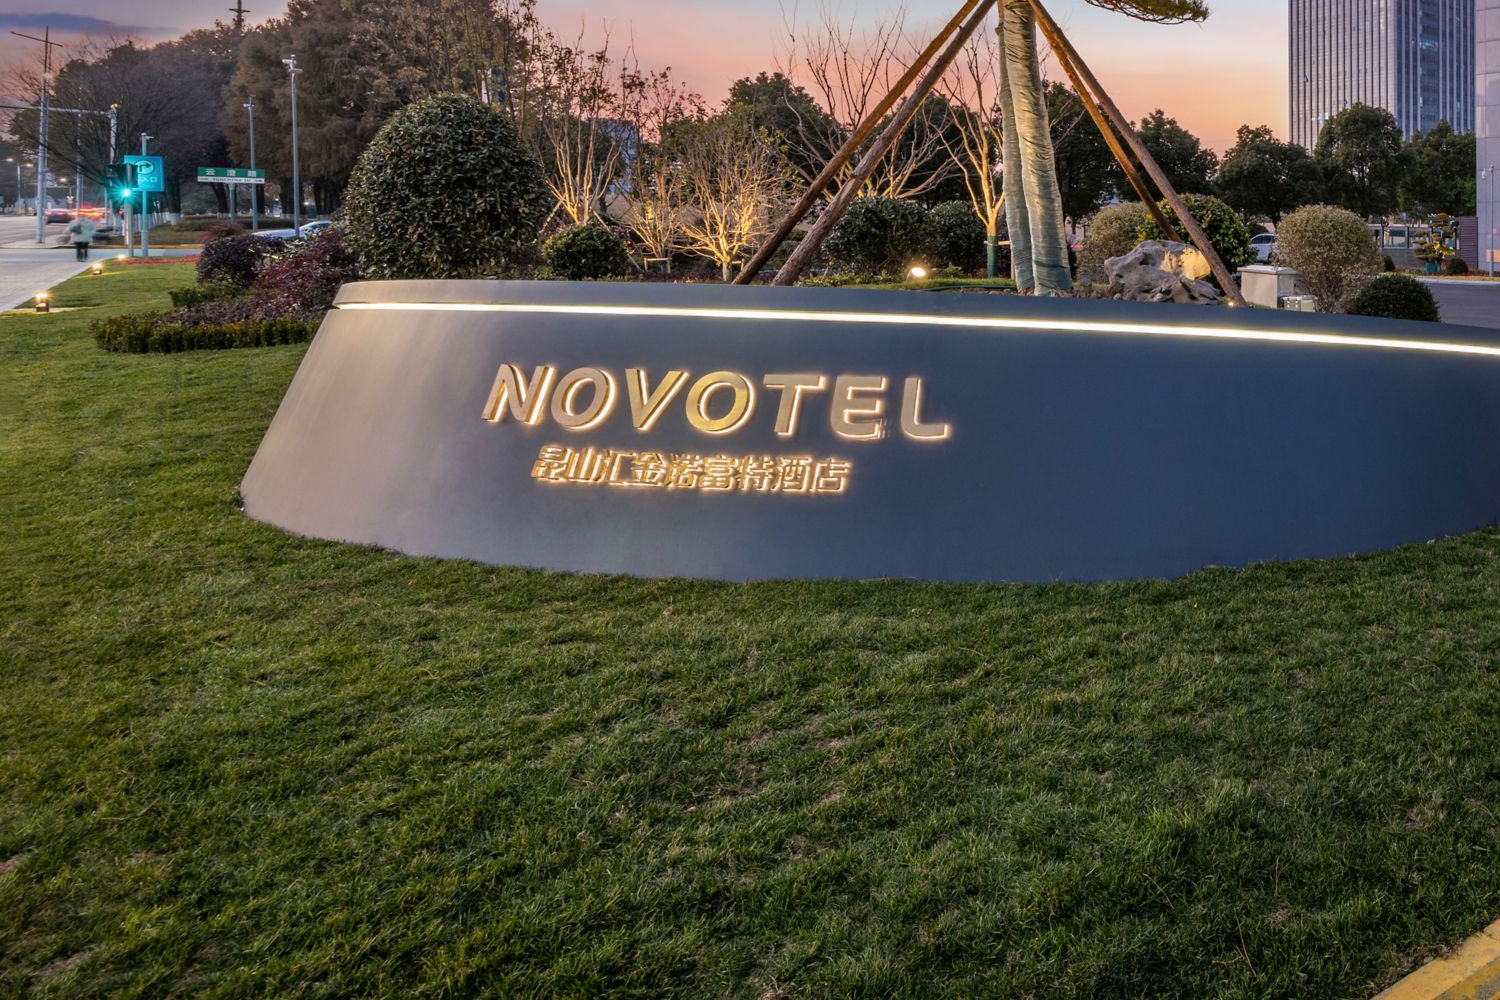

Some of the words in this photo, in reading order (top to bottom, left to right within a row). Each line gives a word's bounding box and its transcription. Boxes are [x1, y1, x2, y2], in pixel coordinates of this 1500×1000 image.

[480, 363, 953, 441] NOVOTEL
[530, 444, 852, 492] 昆山汇金诺富特酒店
